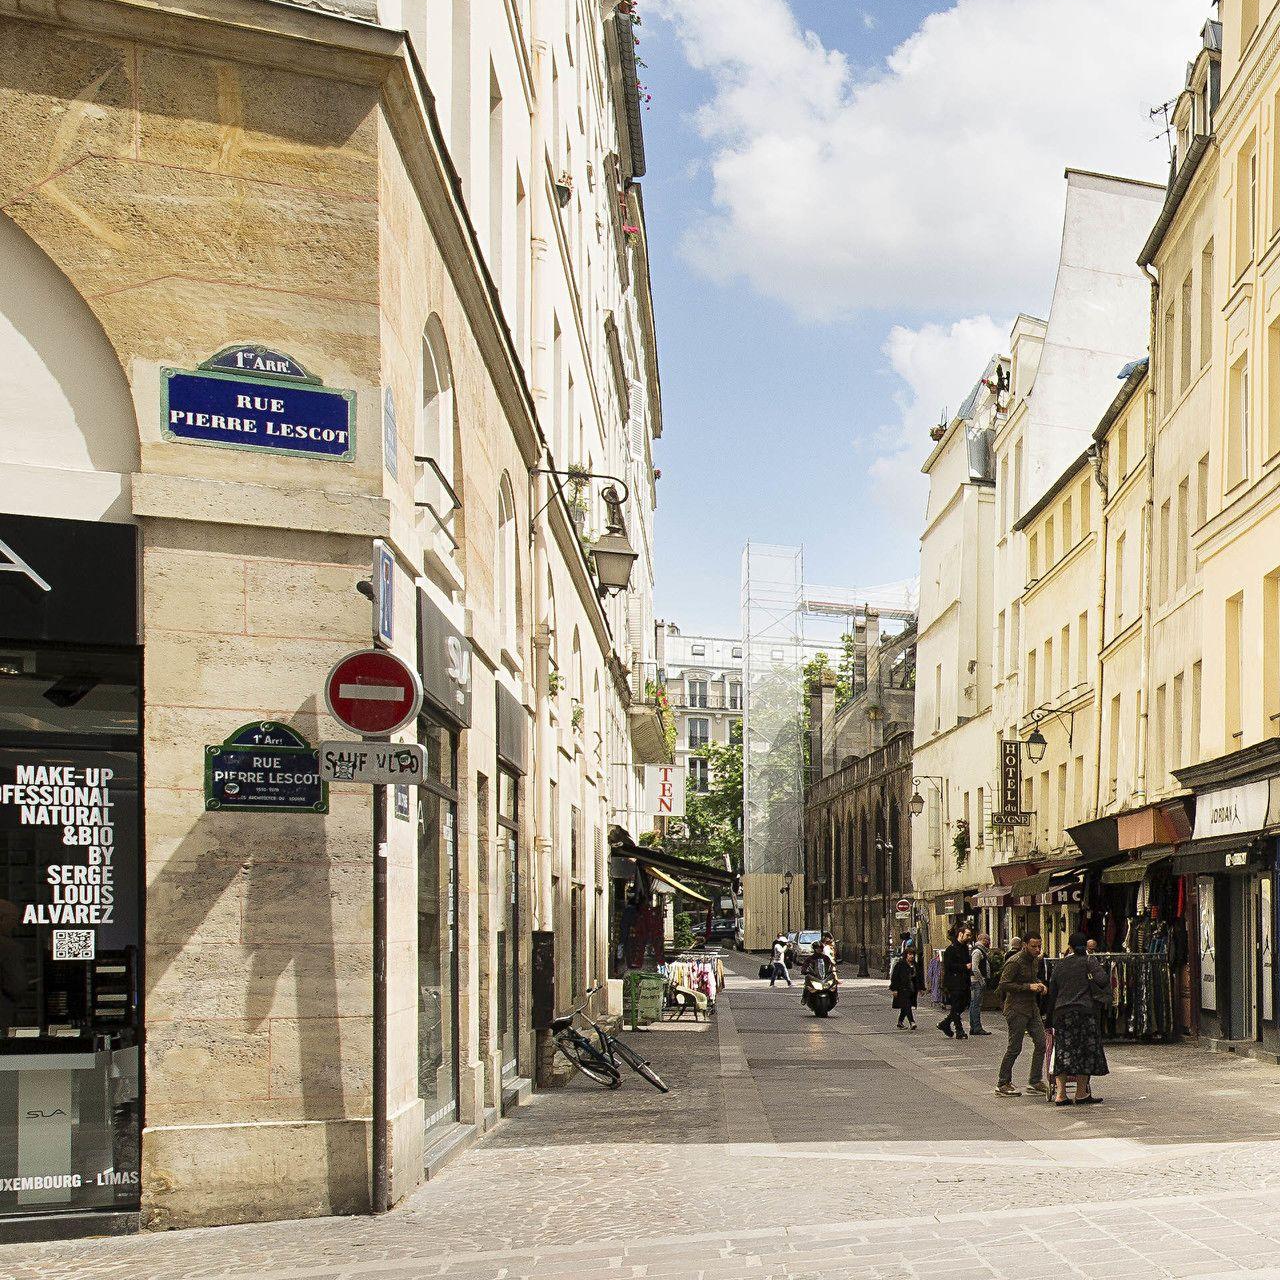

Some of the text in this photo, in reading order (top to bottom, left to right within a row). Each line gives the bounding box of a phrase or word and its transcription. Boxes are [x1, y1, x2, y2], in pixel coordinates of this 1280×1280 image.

[236, 394, 285, 413] RUE
[169, 409, 348, 444] PIERRE LESCOT
[253, 756, 282, 769] RUE
[325, 750, 368, 773] SAUF
[16, 765, 114, 787] MAKE-UP
[214, 770, 320, 785] PIERRE LESCOT
[1005, 744, 1016, 801] HOTEL
[0, 784, 114, 807] FESSIONAL
[657, 767, 674, 813] TEN
[20, 805, 114, 826] NATURAL
[1004, 803, 1017, 812] du
[1210, 805, 1232, 824] JORDAN
[993, 816, 1029, 825] CYGNE
[62, 826, 114, 846] &BIO
[88, 846, 114, 865] BY
[47, 865, 114, 885] SERGE
[53, 885, 114, 905] LOUIS
[22, 904, 114, 924] ALVAREZ
